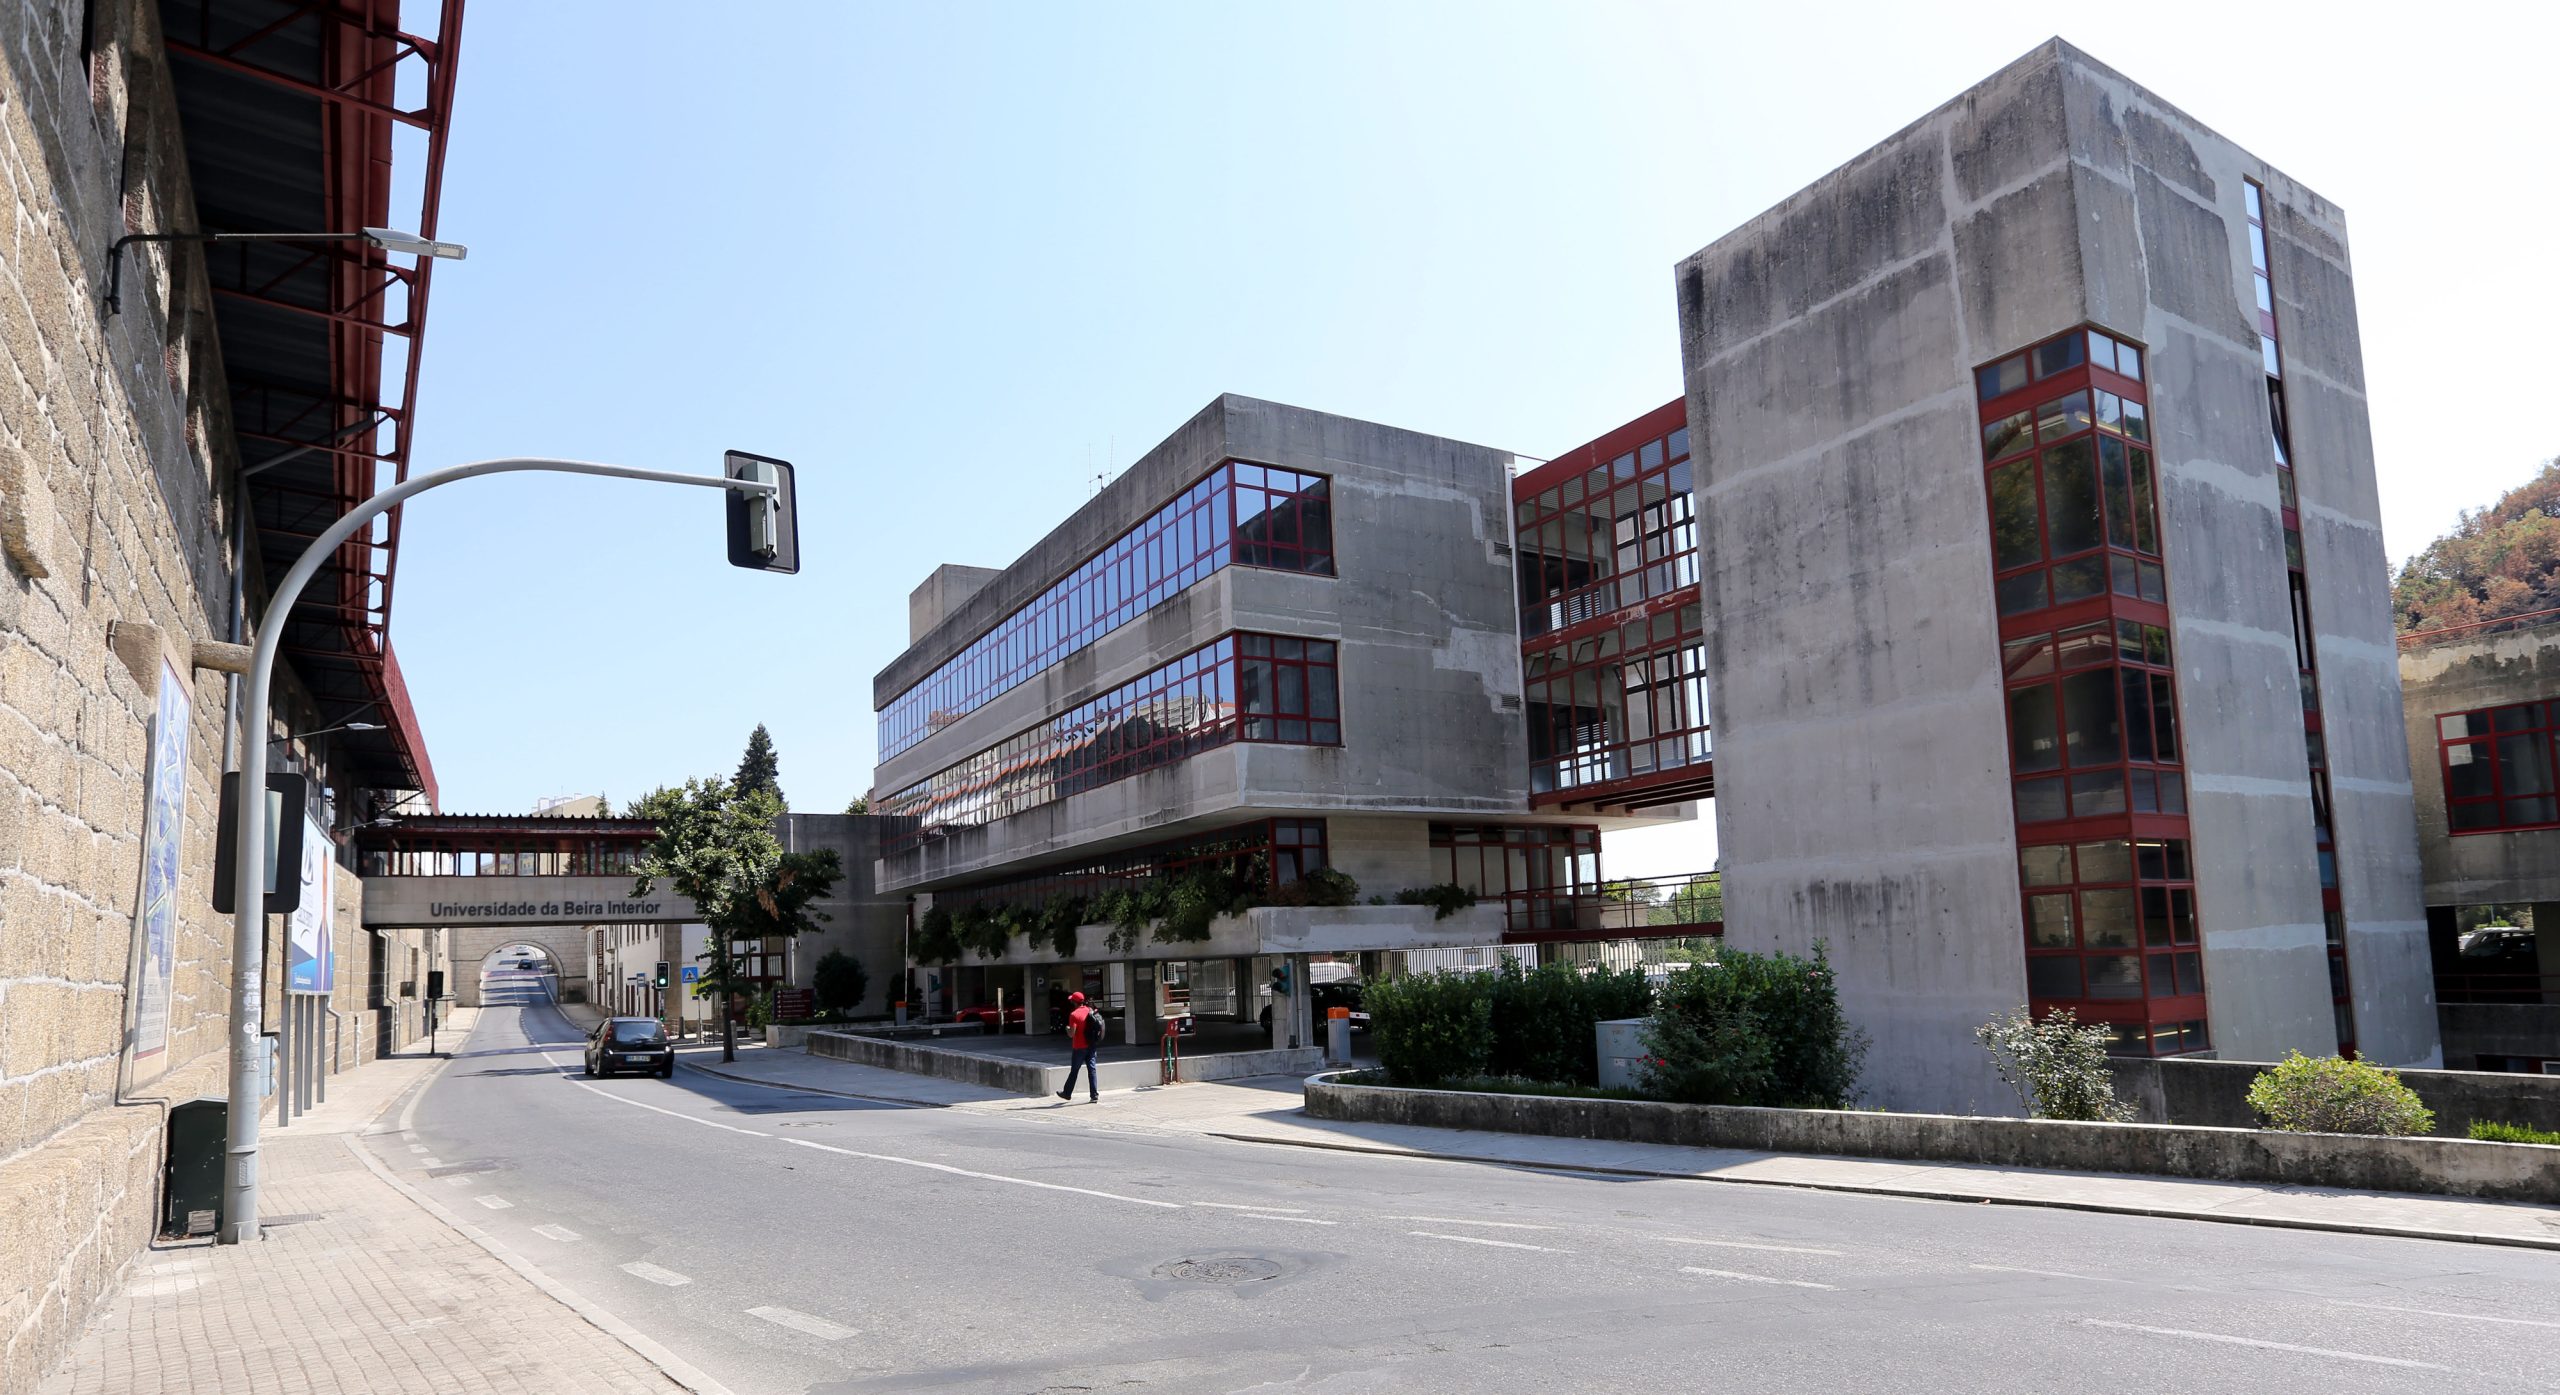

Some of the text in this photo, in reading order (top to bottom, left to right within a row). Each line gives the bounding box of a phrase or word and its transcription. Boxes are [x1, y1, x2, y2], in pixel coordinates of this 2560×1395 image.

[431, 901, 661, 917] Universidade da Beira Interior
[1037, 977, 1045, 988] P
